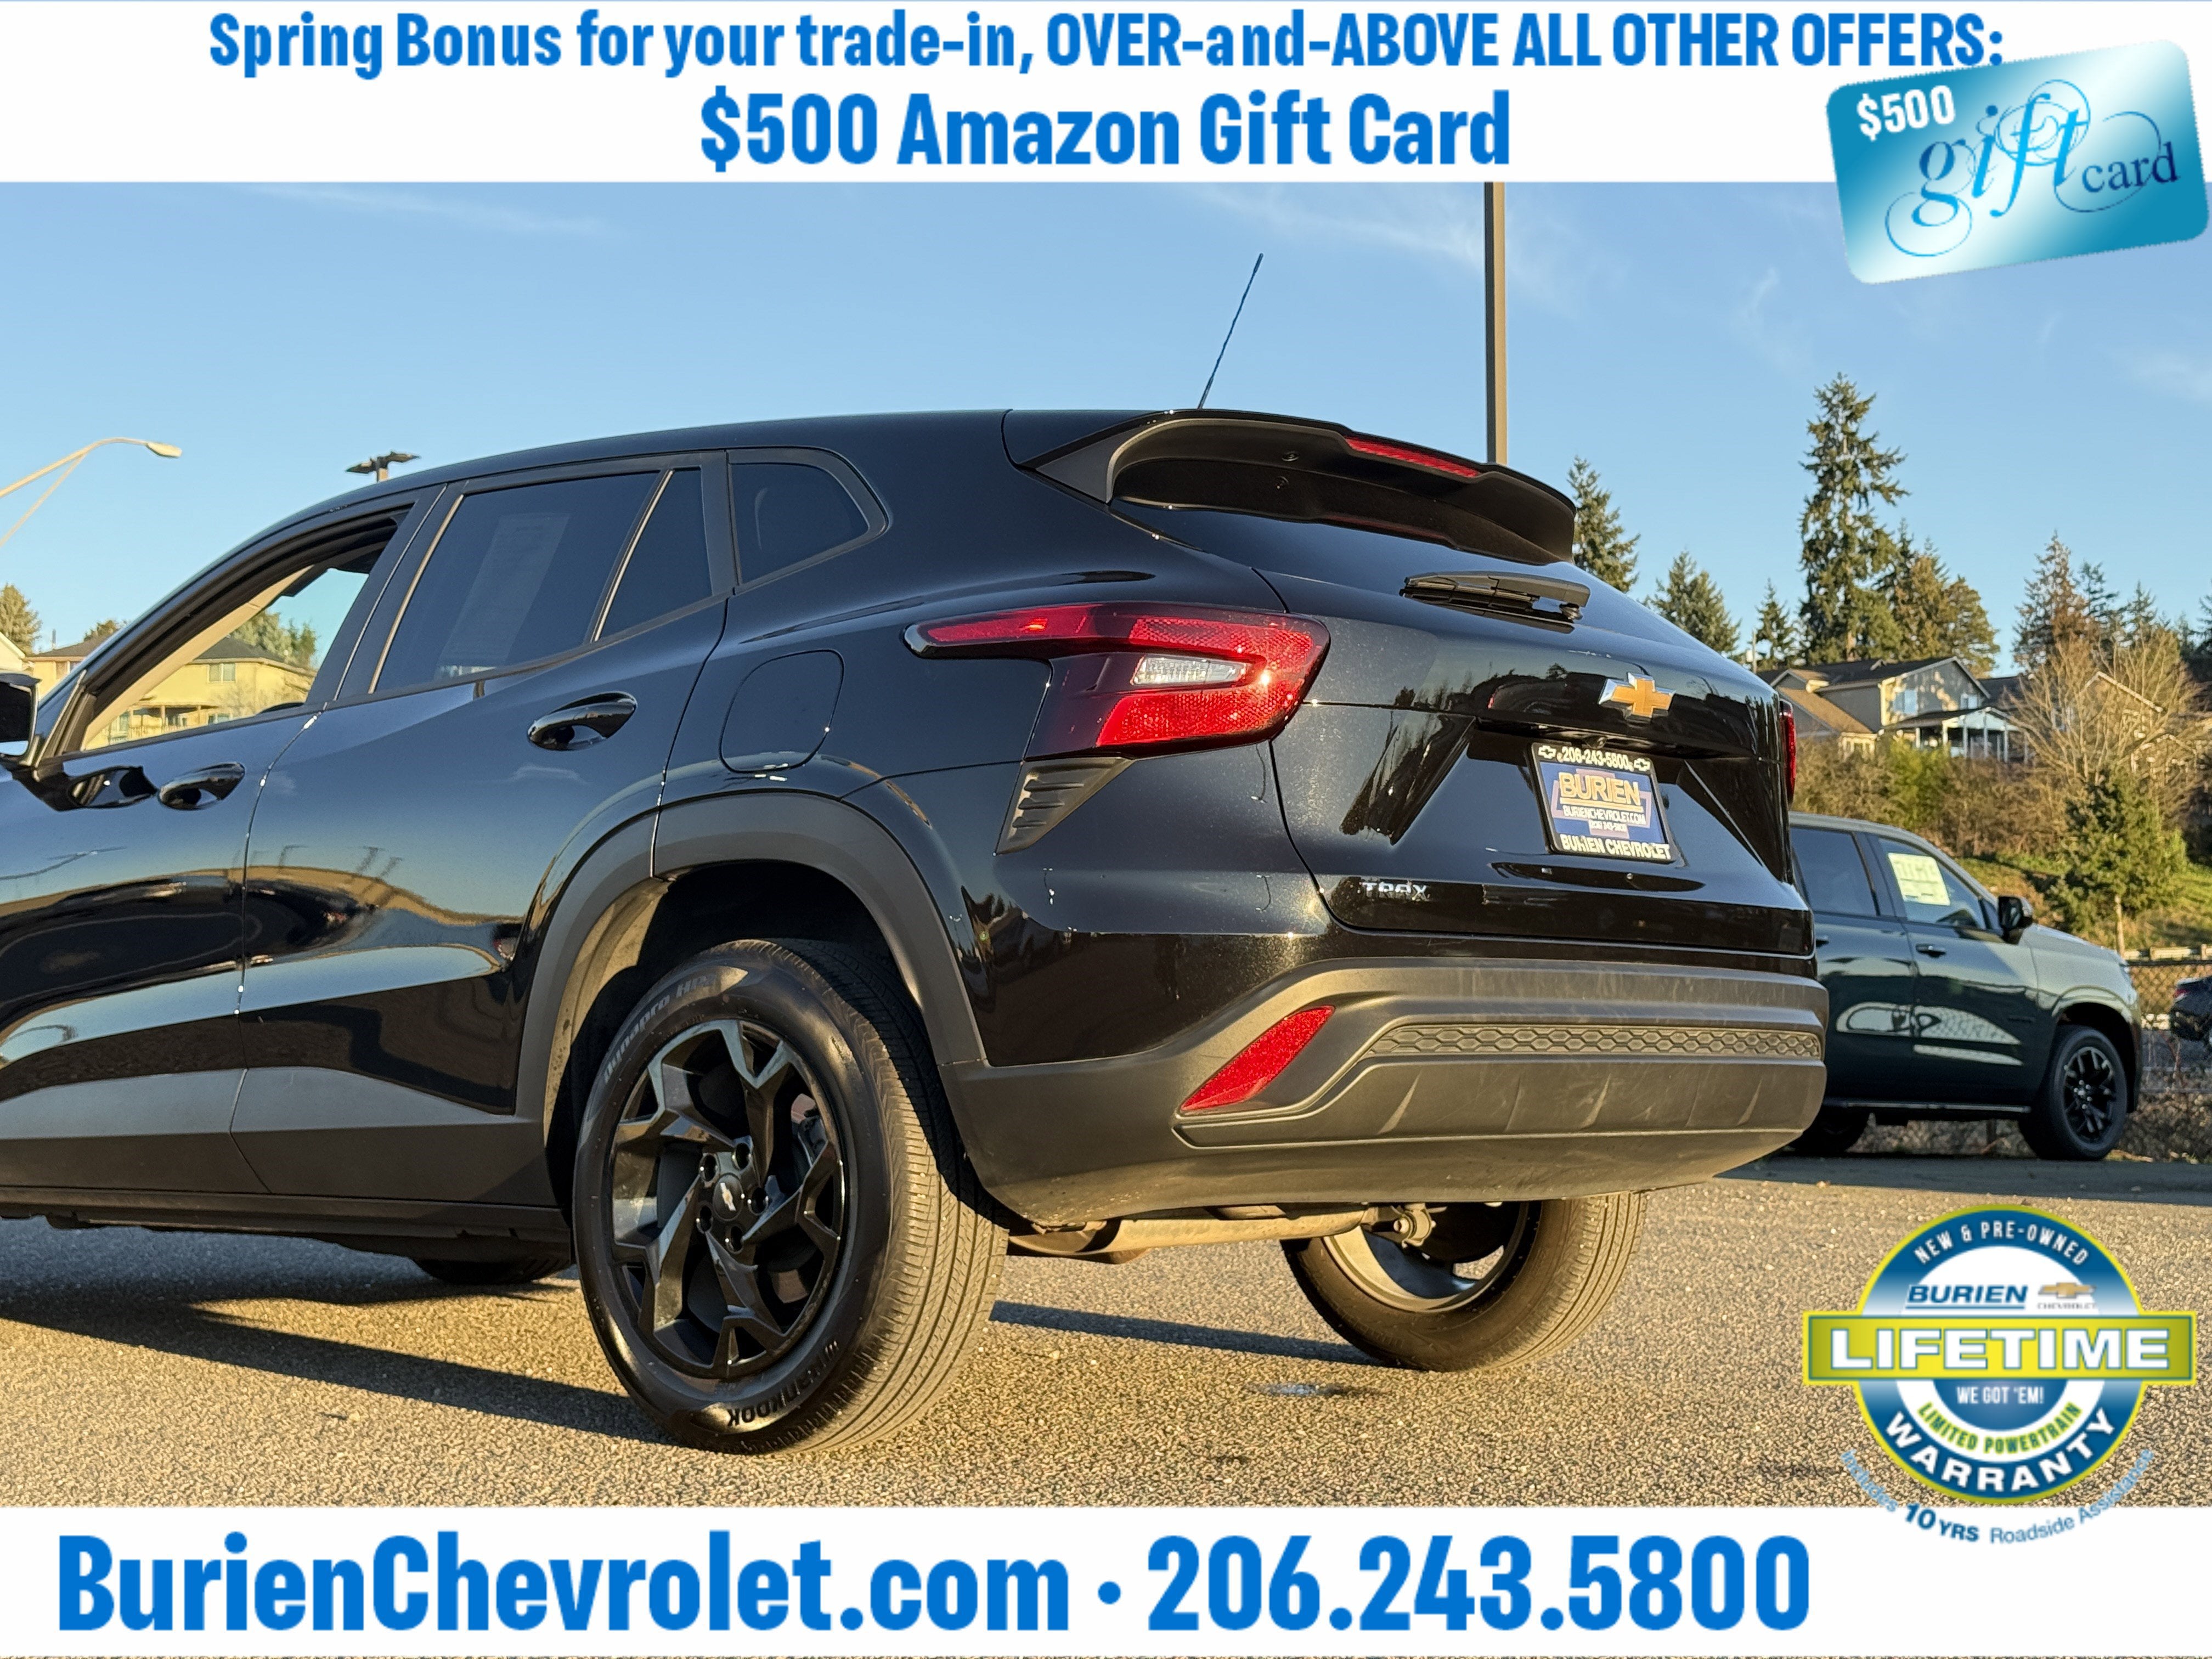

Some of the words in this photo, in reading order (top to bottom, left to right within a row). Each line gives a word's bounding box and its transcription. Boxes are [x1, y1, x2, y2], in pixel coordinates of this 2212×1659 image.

[1561, 746, 1630, 770] 206-243-5800
[1559, 772, 1641, 805] BURIEN
[1562, 805, 1646, 825] BURIENCHEVROLET.COM
[1560, 834, 1606, 854] BURIEN
[1605, 839, 1671, 860] CHEVROLET
